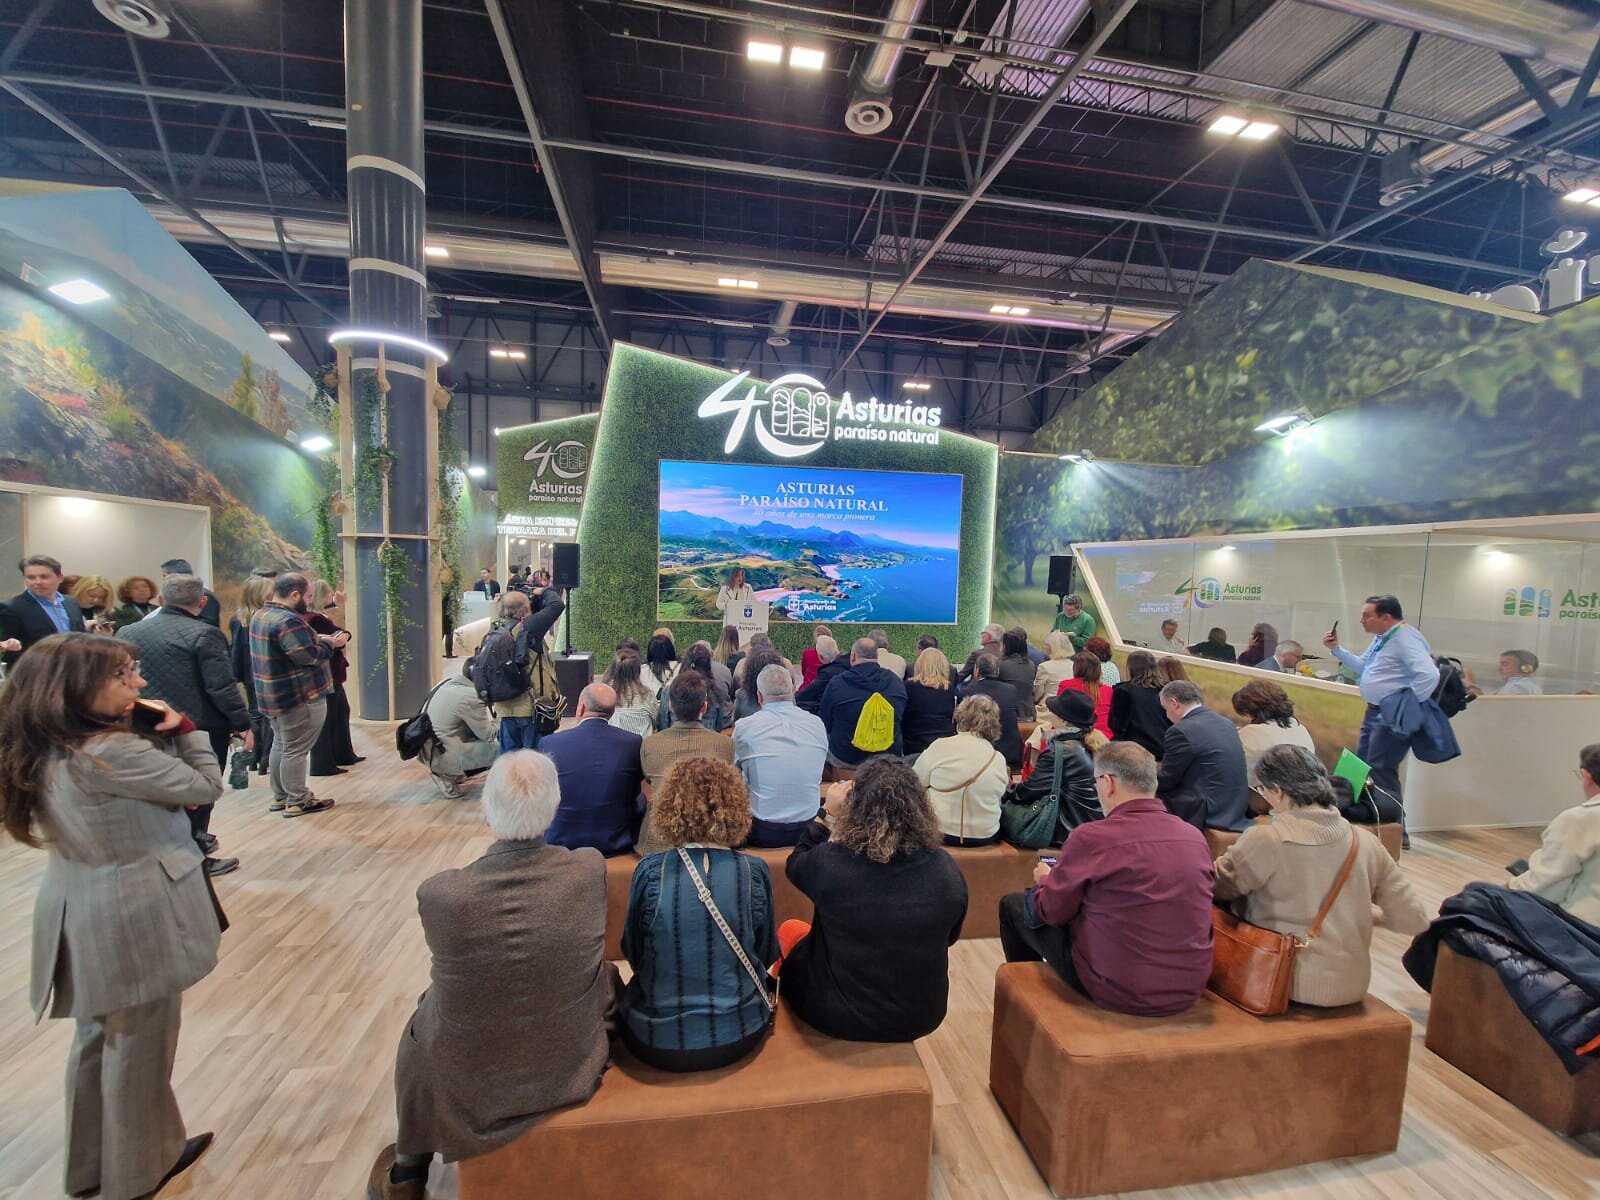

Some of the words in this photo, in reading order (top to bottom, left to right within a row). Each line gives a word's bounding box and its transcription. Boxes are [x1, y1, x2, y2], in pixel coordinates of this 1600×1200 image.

[835, 391, 942, 426] Asturias
[834, 424, 887, 441] paraíso
[888, 429, 940, 445] natural
[529, 479, 583, 494] Asturias
[776, 481, 855, 496] ASTURIAS
[528, 494, 556, 503] paraíso
[557, 495, 583, 503] natural
[739, 494, 810, 508] PARAÍSO
[814, 498, 888, 512] NATURAL
[766, 510, 785, 518] años
[787, 510, 798, 518] de
[799, 511, 815, 519] una
[816, 512, 843, 520] marca
[842, 512, 876, 522] pionera
[1223, 582, 1262, 594] Asturias
[1559, 589, 1600, 608] Ast
[1559, 609, 1600, 620] paraís
